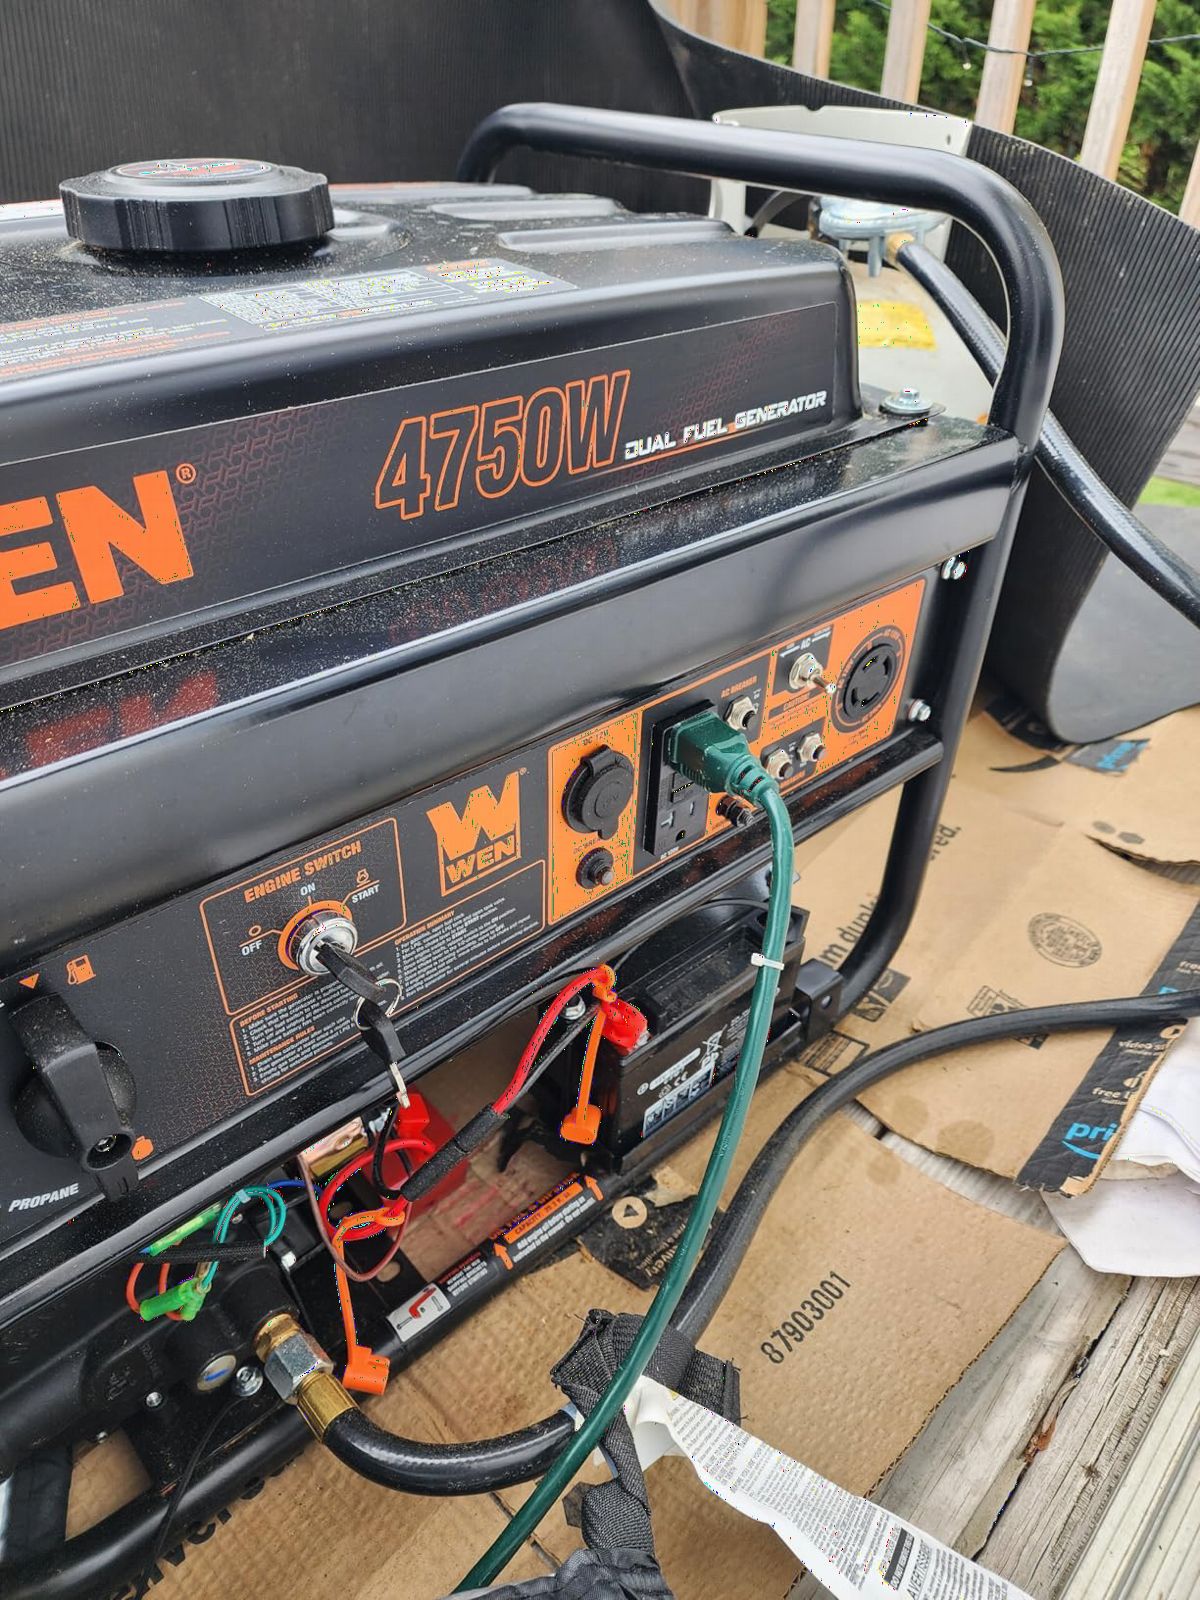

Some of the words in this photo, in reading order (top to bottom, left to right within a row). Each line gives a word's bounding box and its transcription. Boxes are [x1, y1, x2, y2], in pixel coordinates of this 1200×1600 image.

[625, 432, 676, 460] DUAL
[683, 416, 728, 448] FUEL
[735, 390, 827, 430] GENERATOR
[375, 369, 631, 520] 4750W
[244, 864, 302, 903] ENGINE
[303, 840, 362, 876] SWITCH
[445, 834, 519, 884] WEN
[300, 882, 316, 897] ON
[351, 884, 380, 904] START
[241, 940, 263, 956] OFF
[1091, 1086, 1122, 1099] free
[1063, 1122, 1122, 1143] pri
[8, 1182, 79, 1213] PROPANE
[761, 1270, 851, 1364] 87903001
